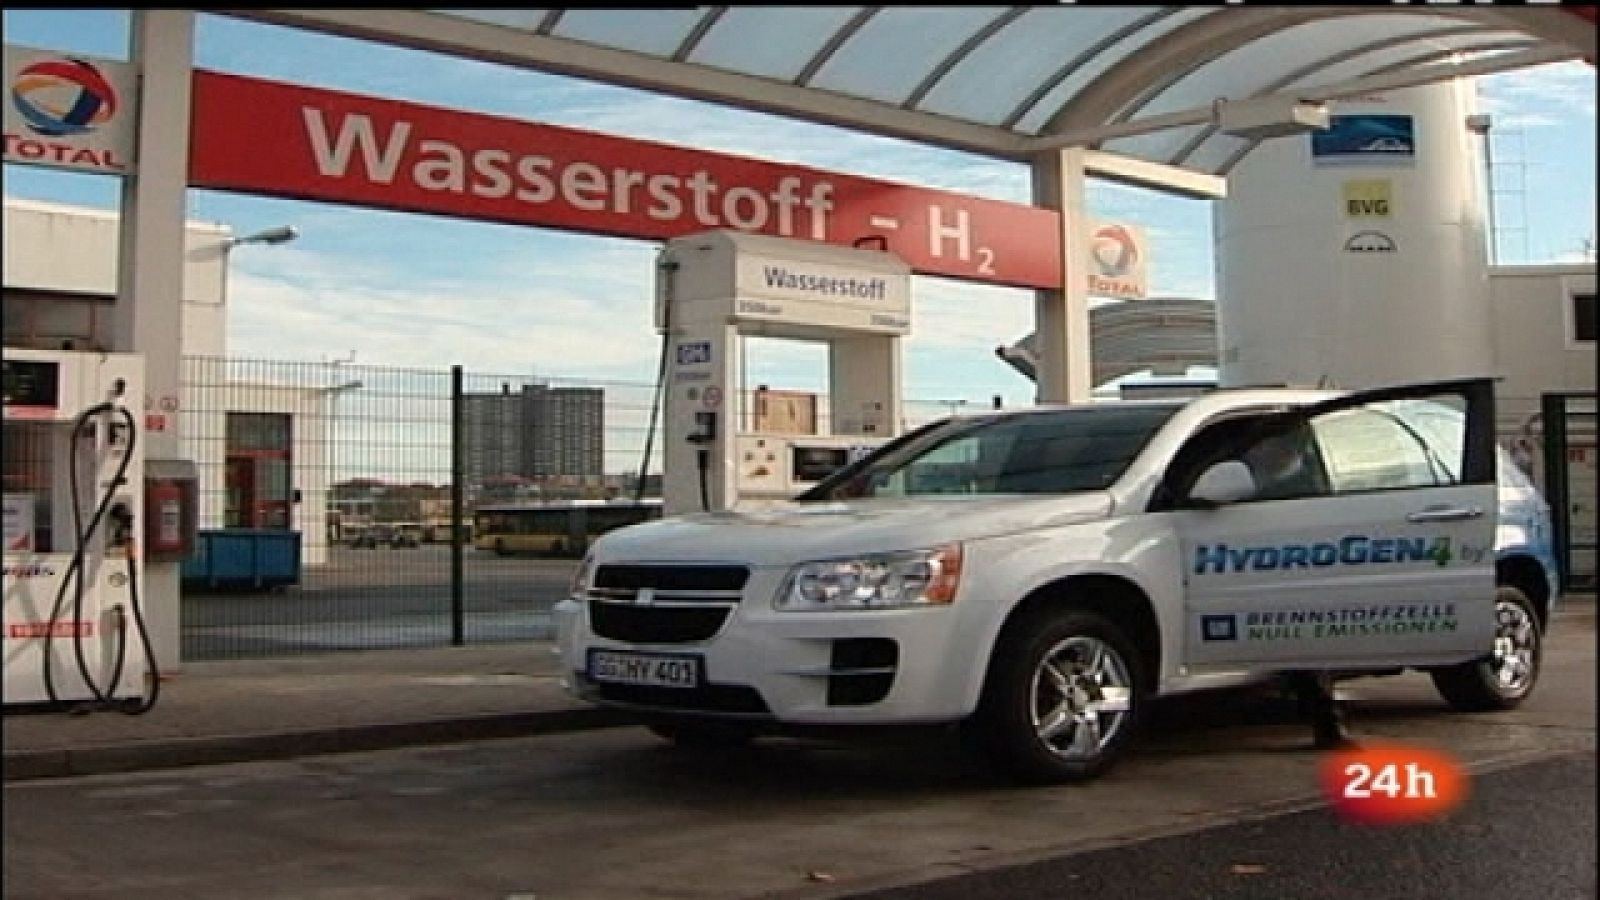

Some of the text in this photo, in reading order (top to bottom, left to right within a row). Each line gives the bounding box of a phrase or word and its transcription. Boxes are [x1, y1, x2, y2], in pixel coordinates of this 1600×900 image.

[303, 106, 834, 240] Wasserstoff
[1347, 199, 1389, 215] BVG
[764, 266, 887, 300] Wasserstoff
[1247, 604, 1456, 626] BRENNSTOFFZELLE
[1248, 619, 1458, 641] NULL EMISSIONEN
